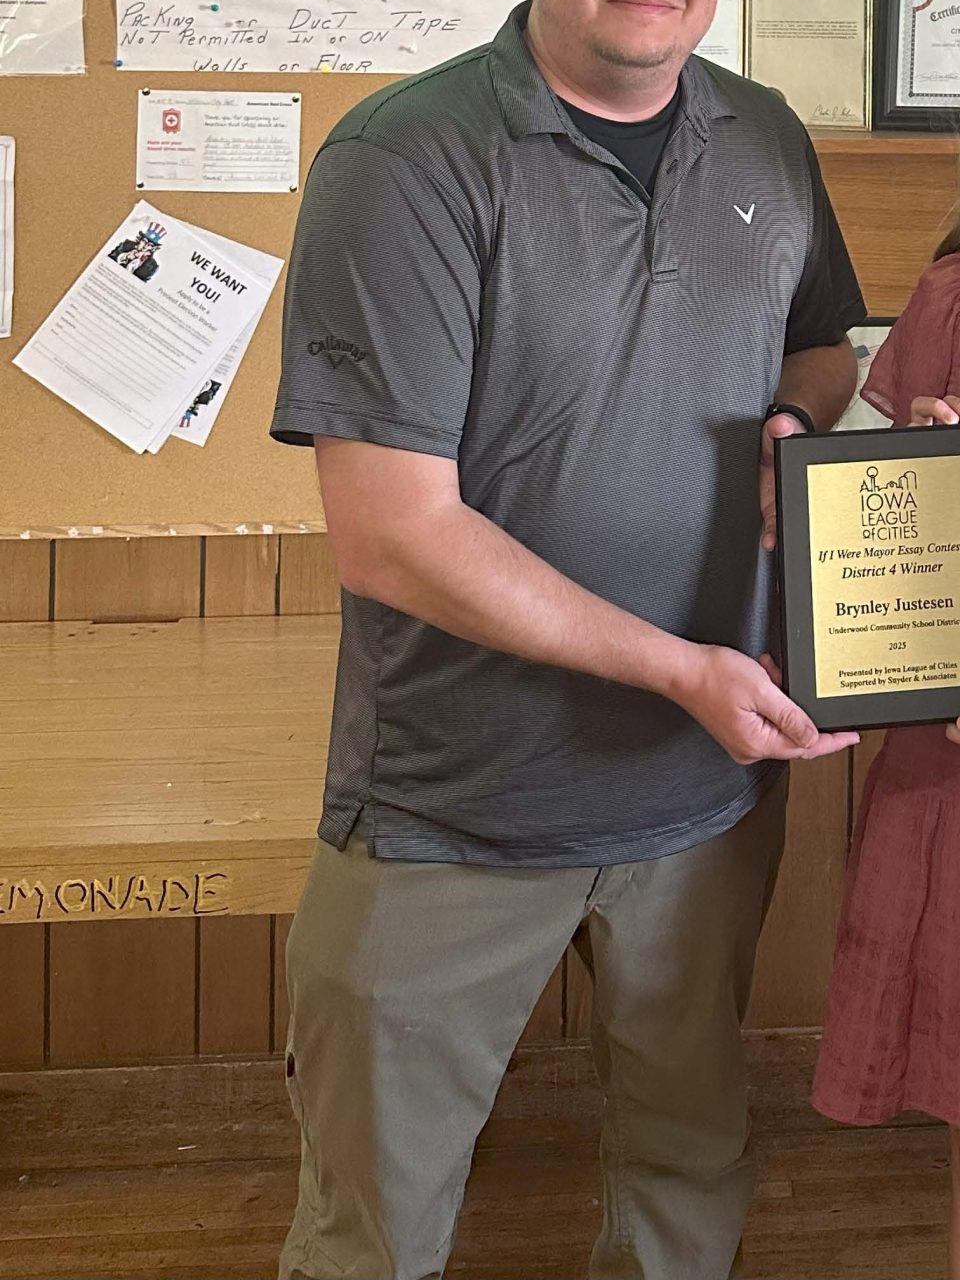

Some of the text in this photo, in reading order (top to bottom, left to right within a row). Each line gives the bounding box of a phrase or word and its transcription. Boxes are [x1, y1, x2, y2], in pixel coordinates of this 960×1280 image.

[390, 11, 462, 36] TAPE
[330, 35, 346, 44] or
[359, 31, 389, 44] ON
[279, 63, 299, 72] or
[190, 251, 247, 295] WE WANT
[190, 277, 222, 303] YOU!
[307, 335, 369, 362] Callaway
[861, 492, 917, 511] IOWA
[861, 510, 917, 527] LEAGUE
[818, 550, 828, 562] If
[829, 549, 835, 560] I
[837, 548, 860, 560] Were
[864, 546, 895, 560] Mayor
[898, 544, 925, 557] Essay
[842, 562, 943, 580] District 4 Winner
[836, 597, 954, 618] Brynley Justesen
[829, 624, 868, 635] Underwood
[870, 622, 910, 633] Community
[912, 619, 935, 629] School
[889, 642, 907, 651] 2025
[839, 668, 873, 677] Presented
[840, 677, 876, 688] Supported
